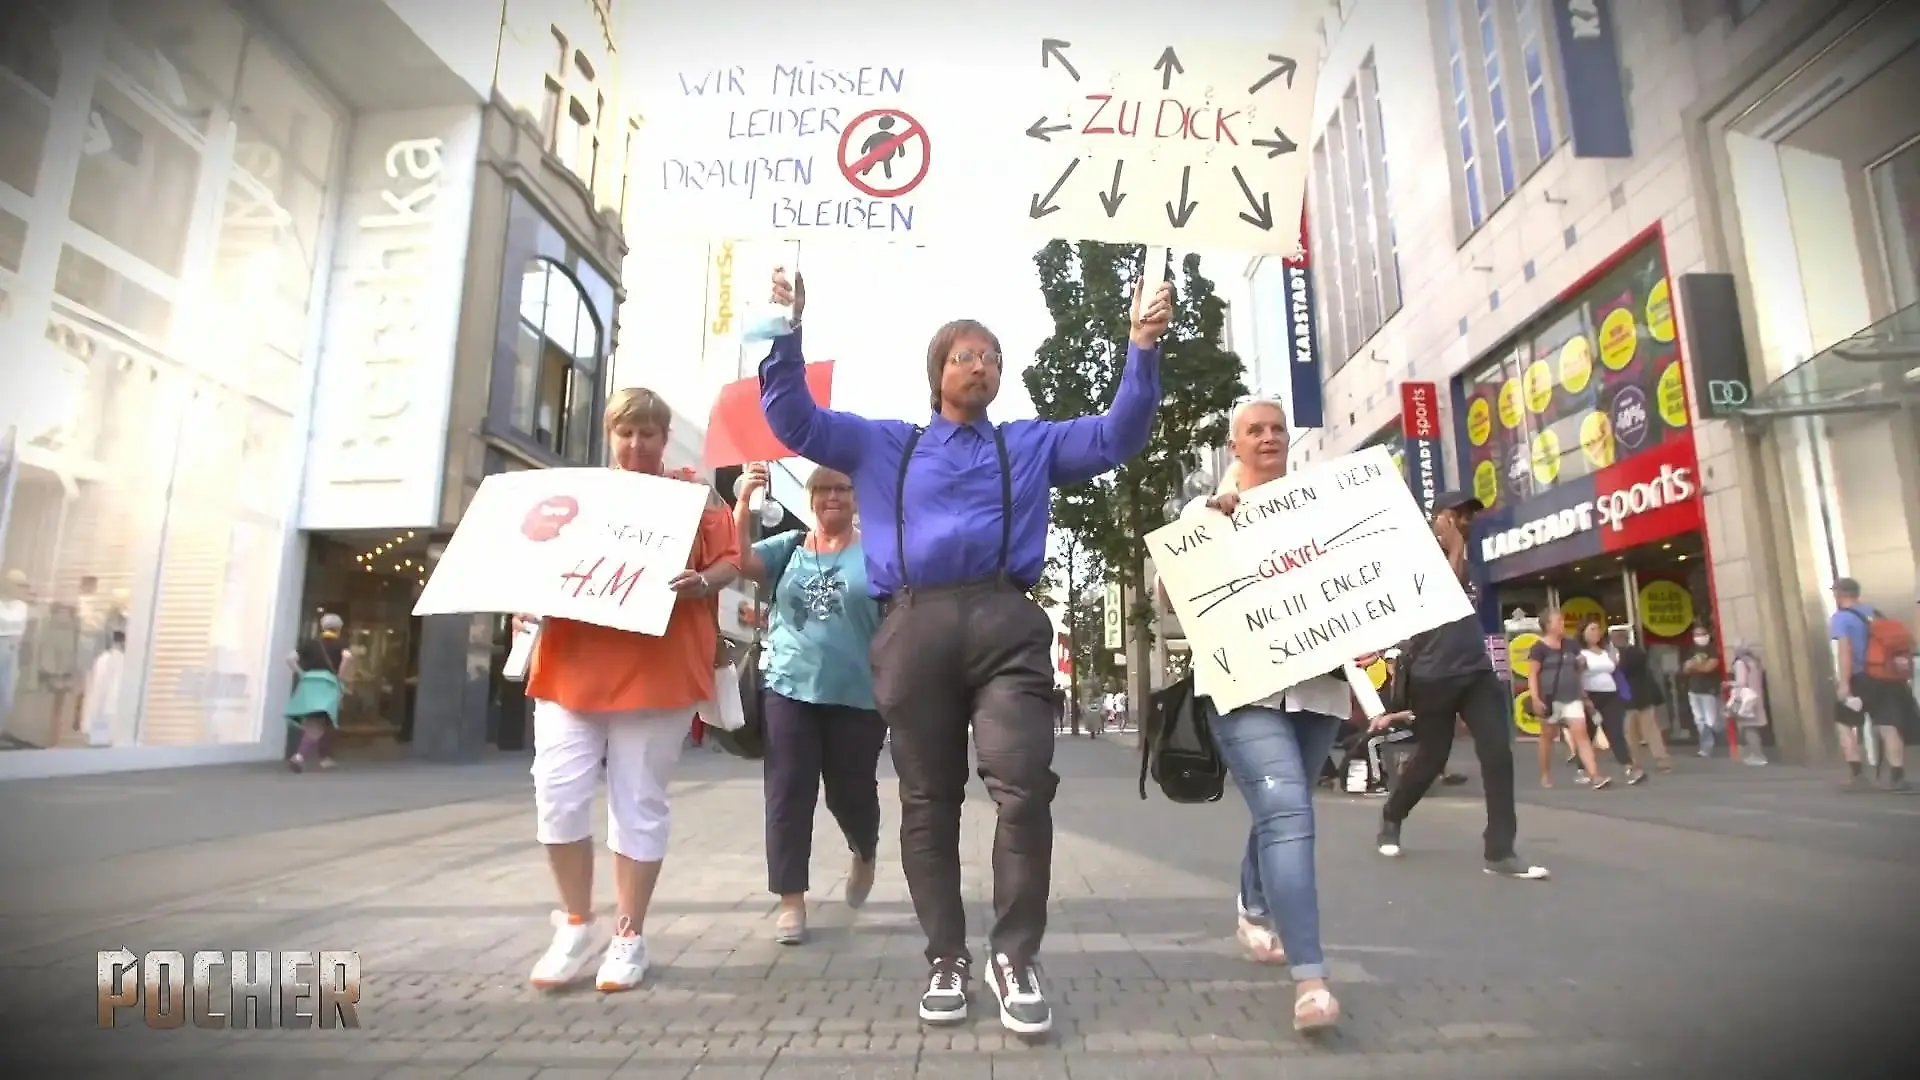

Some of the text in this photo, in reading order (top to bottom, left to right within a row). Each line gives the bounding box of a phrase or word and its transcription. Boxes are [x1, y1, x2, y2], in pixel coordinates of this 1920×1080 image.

[679, 60, 904, 97] WIR MÜSSEN
[729, 107, 841, 139] LEIDER
[1155, 98, 1241, 146] DICK
[772, 197, 914, 231] BLEIBEN
[1289, 267, 1313, 363] KARSTADT
[1412, 387, 1433, 437] sports
[1482, 464, 1695, 562] KARSTADT sports
[1164, 524, 1213, 556] WIR
